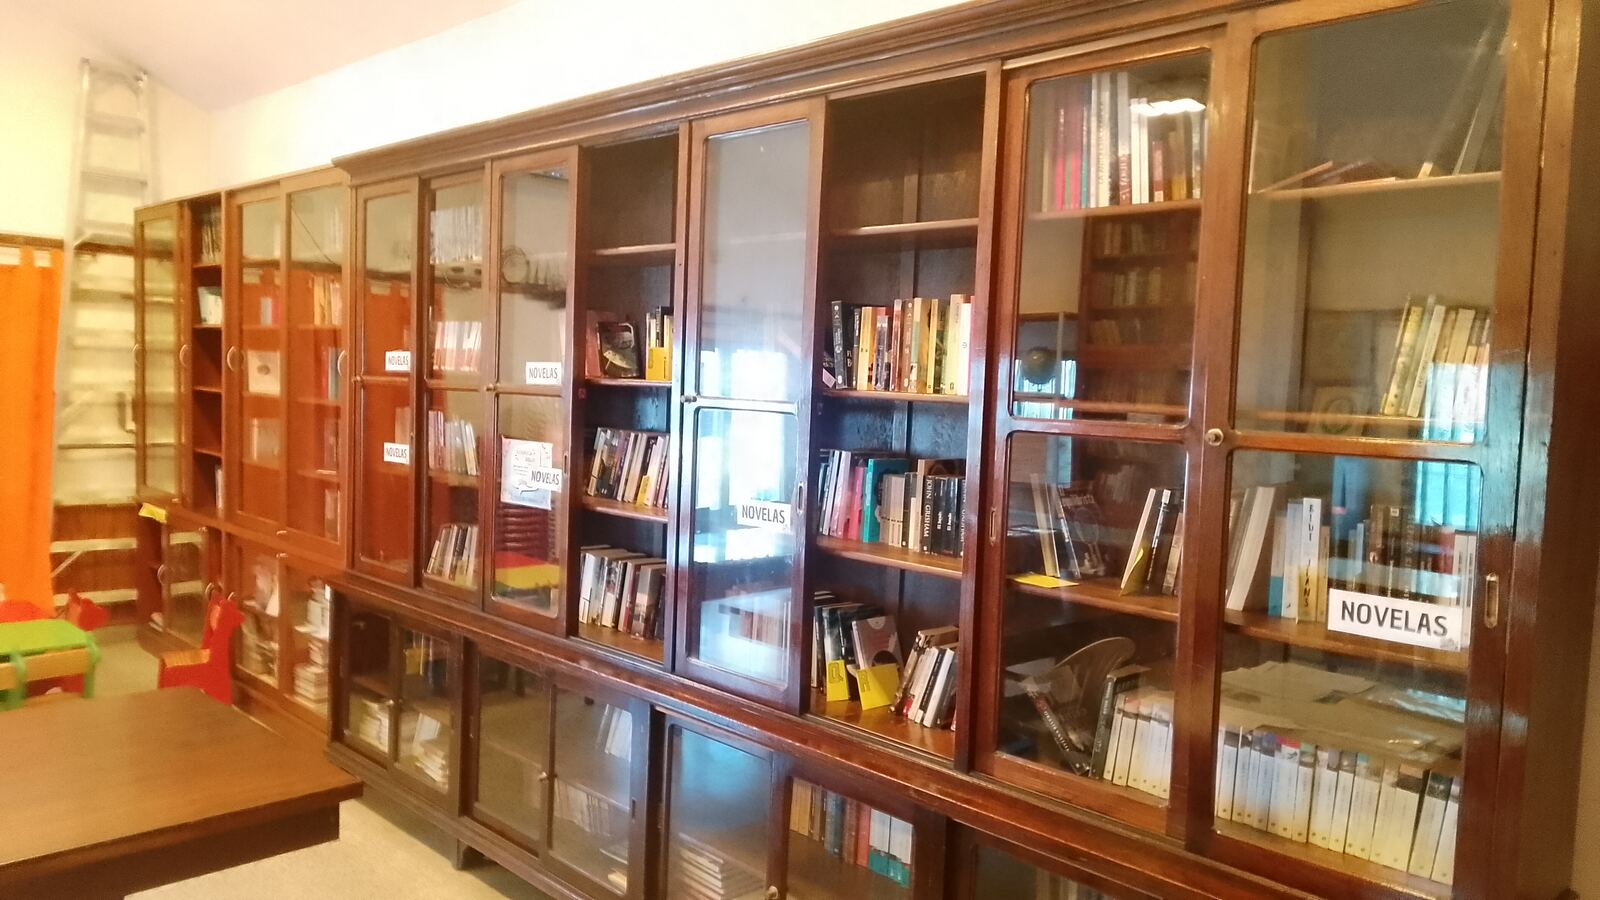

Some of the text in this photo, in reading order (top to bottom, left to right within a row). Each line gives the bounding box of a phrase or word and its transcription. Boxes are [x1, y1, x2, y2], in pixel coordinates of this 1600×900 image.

[529, 367, 558, 379] NOVELAS
[531, 470, 560, 486] NOVELAS
[741, 504, 785, 524] NOVELAS
[1341, 599, 1448, 638] NOVELAS
